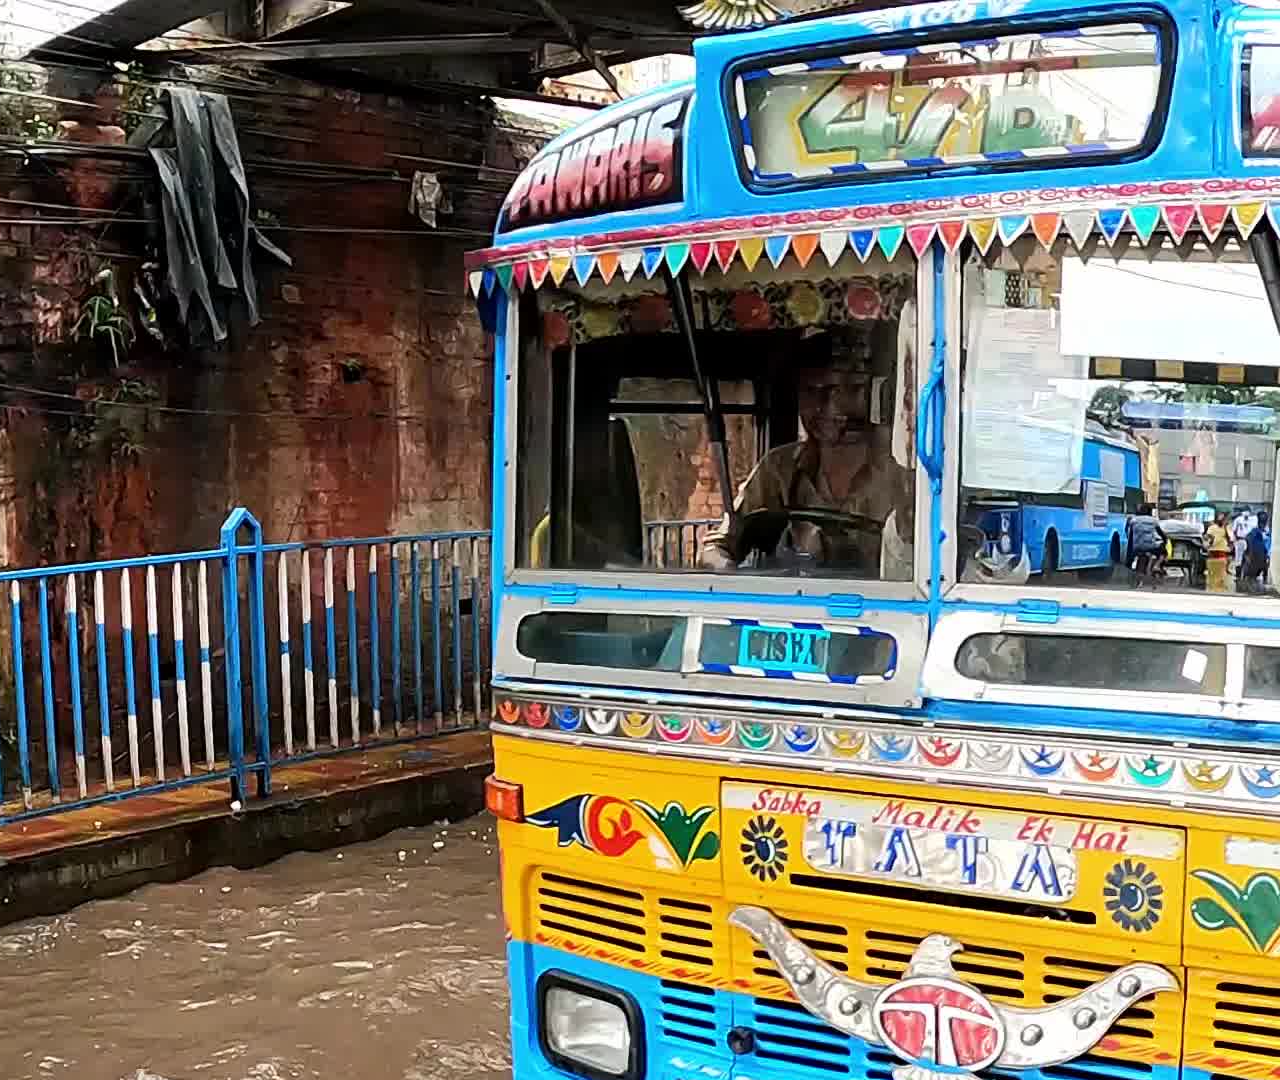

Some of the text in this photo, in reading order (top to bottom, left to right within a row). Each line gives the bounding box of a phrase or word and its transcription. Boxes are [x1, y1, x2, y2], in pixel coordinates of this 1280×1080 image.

[752, 788, 1131, 852] Sabka Malik Ek Hai
[821, 820, 1063, 897] TATA
